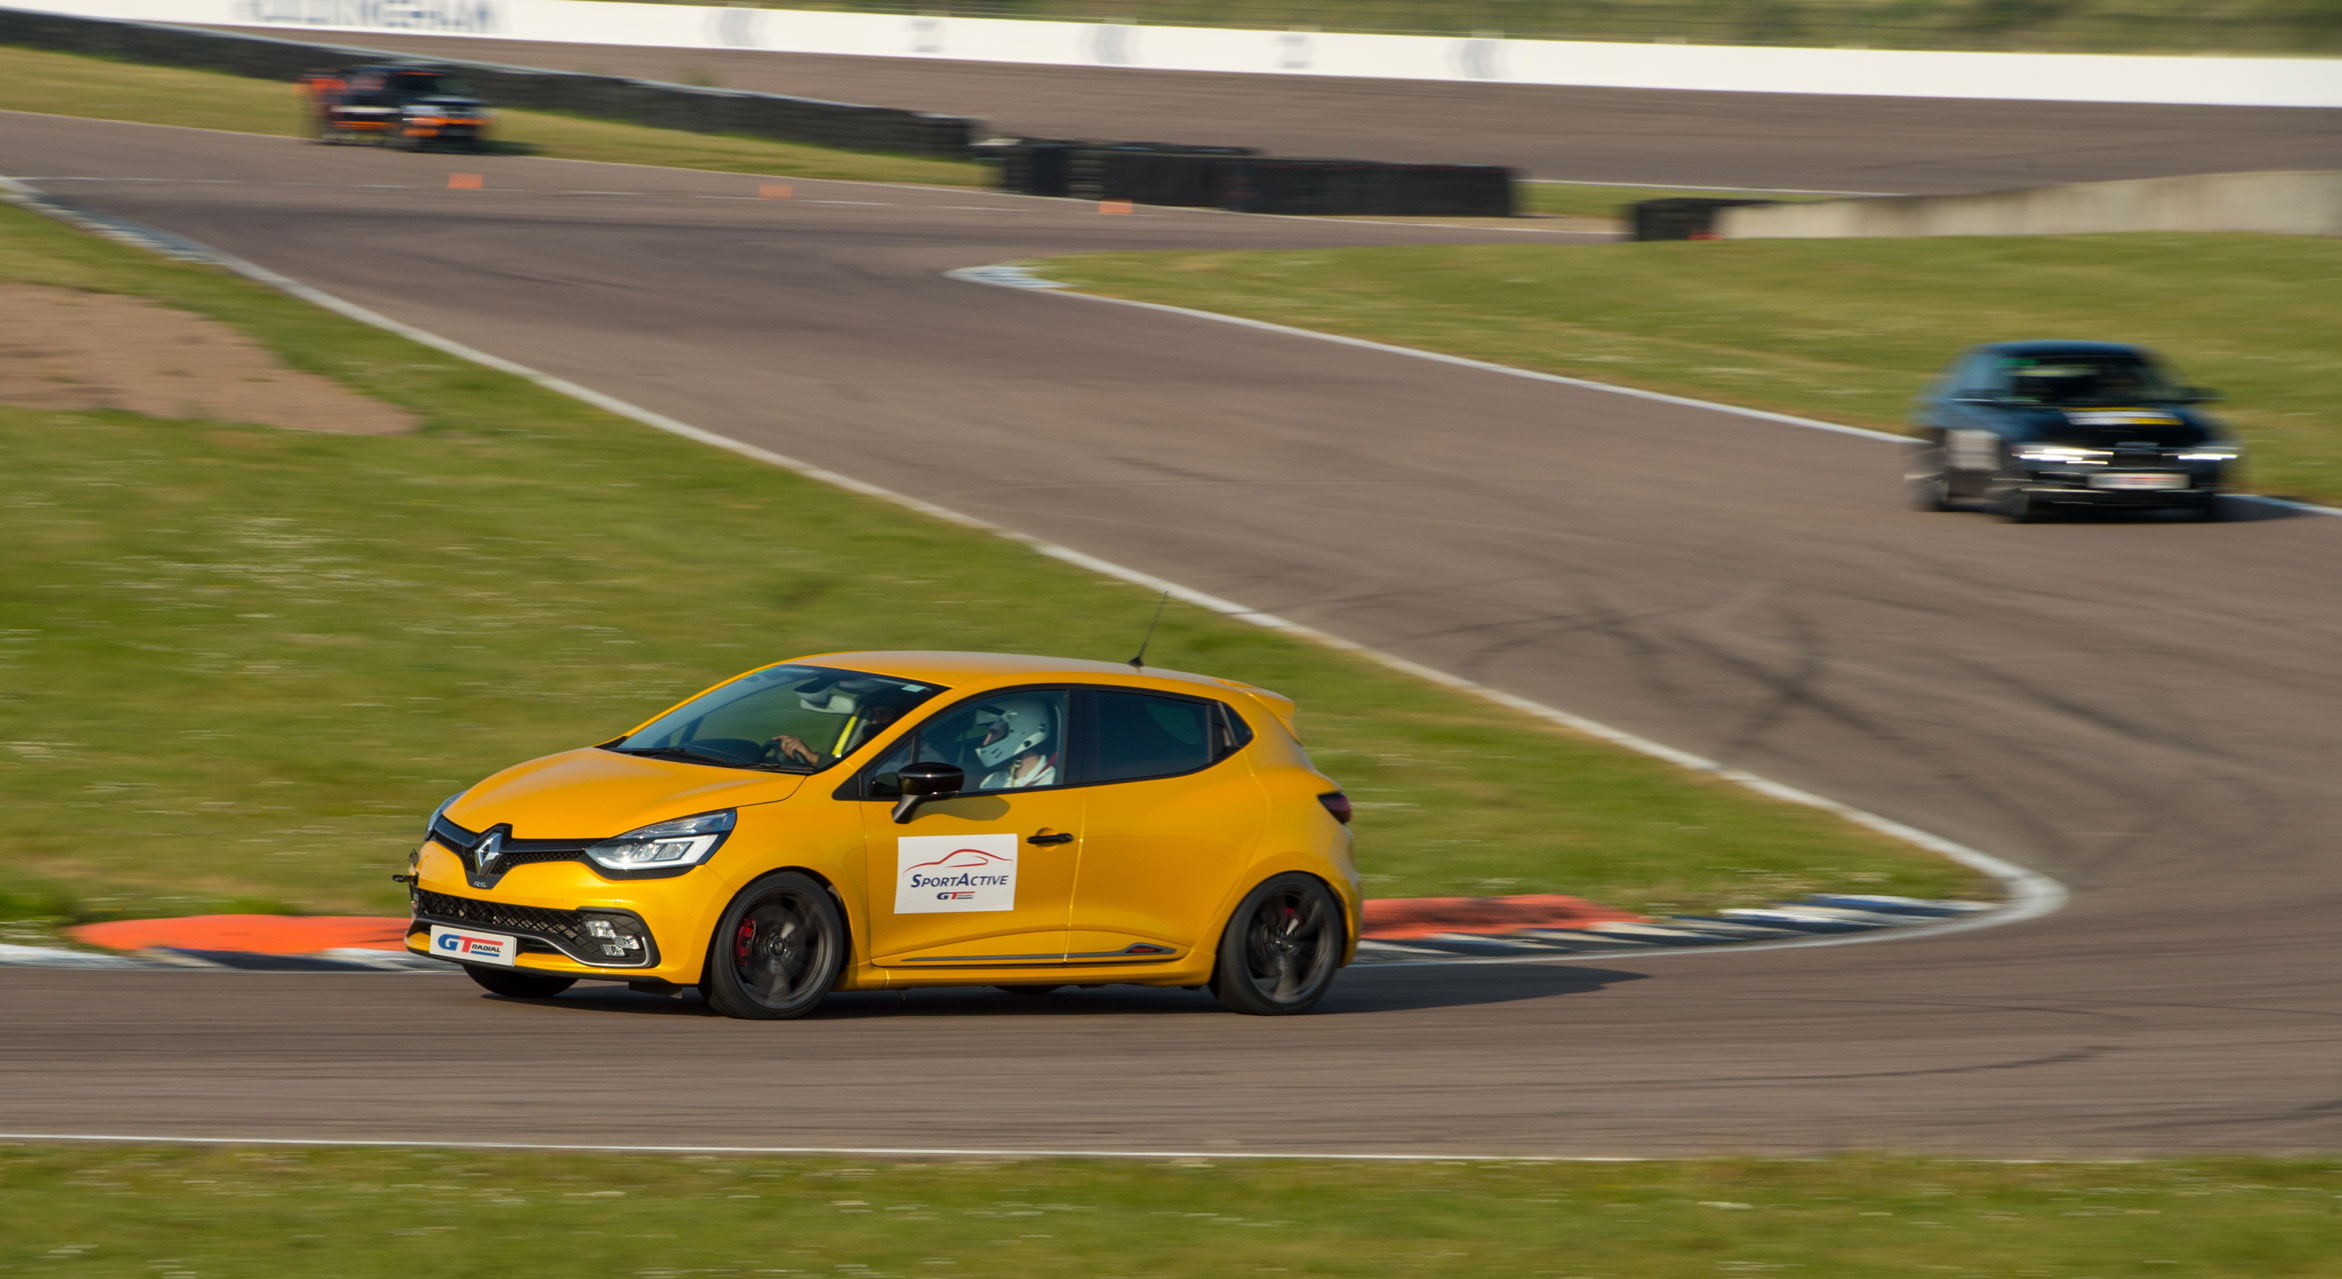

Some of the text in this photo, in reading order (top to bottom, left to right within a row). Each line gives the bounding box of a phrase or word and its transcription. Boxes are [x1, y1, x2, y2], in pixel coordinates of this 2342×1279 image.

[937, 891, 975, 900] GT
[438, 934, 503, 953] GT RADIAL
